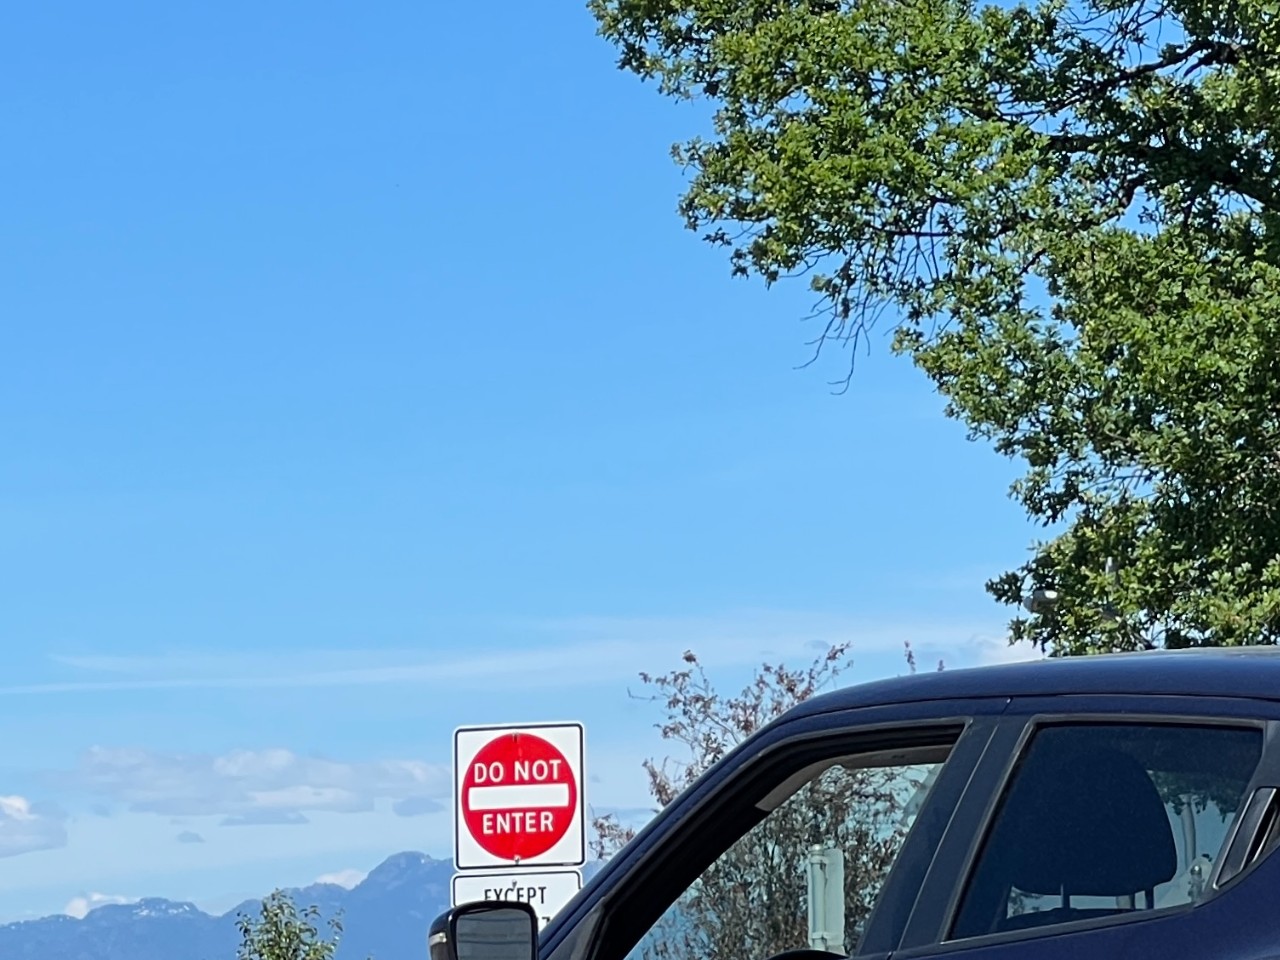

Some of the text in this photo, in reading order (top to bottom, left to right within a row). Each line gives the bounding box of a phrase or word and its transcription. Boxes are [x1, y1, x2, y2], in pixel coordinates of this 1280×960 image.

[474, 759, 562, 783] DO NOT
[482, 811, 554, 835] ENTER
[484, 886, 547, 904] EXCEPT
